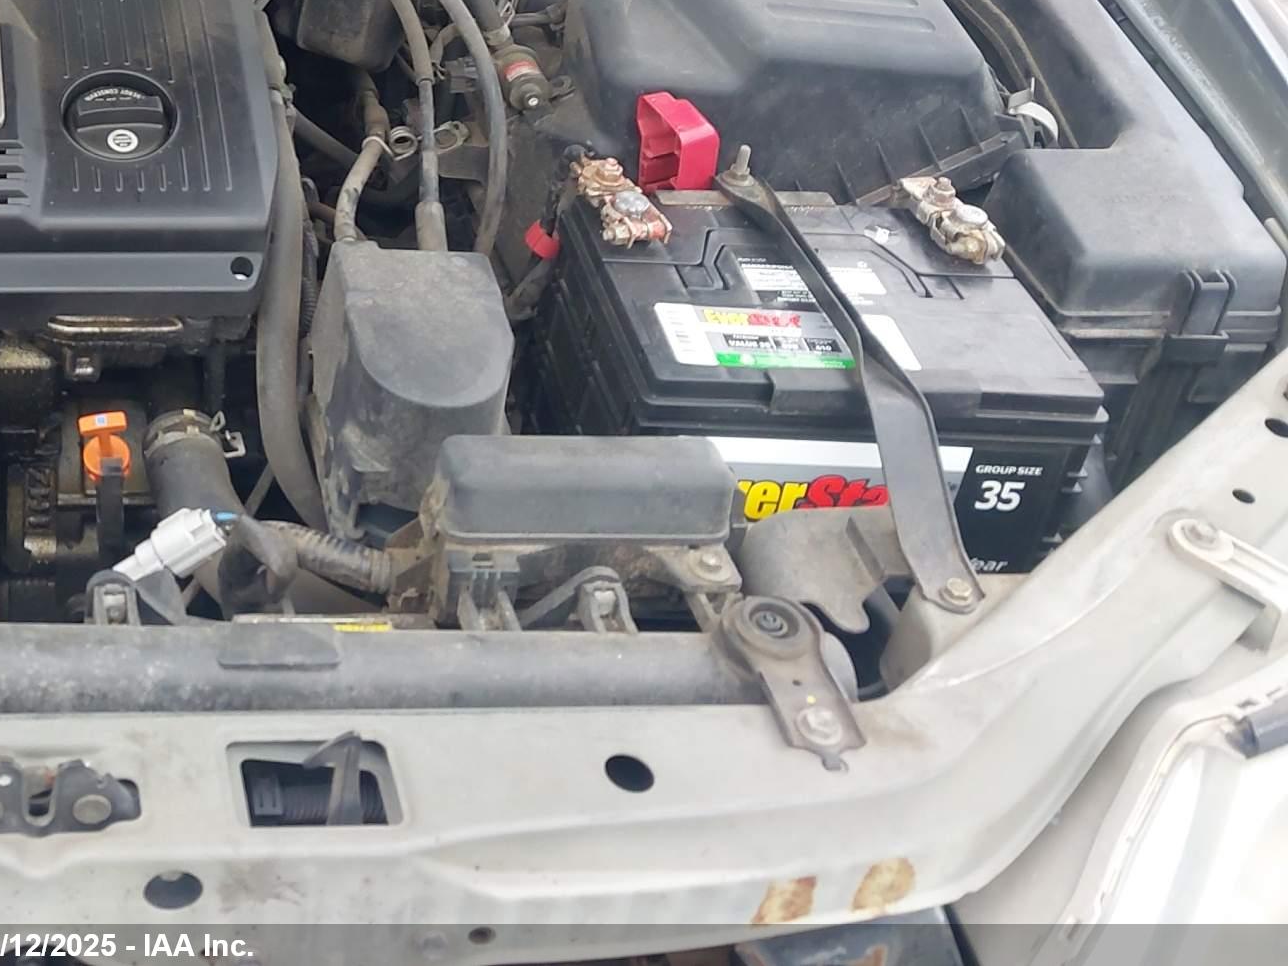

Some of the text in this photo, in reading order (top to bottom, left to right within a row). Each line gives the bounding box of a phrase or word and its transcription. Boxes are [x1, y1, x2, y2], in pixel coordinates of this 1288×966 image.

[975, 465, 1044, 476] GROUP SIZE
[974, 480, 1026, 511] 35
